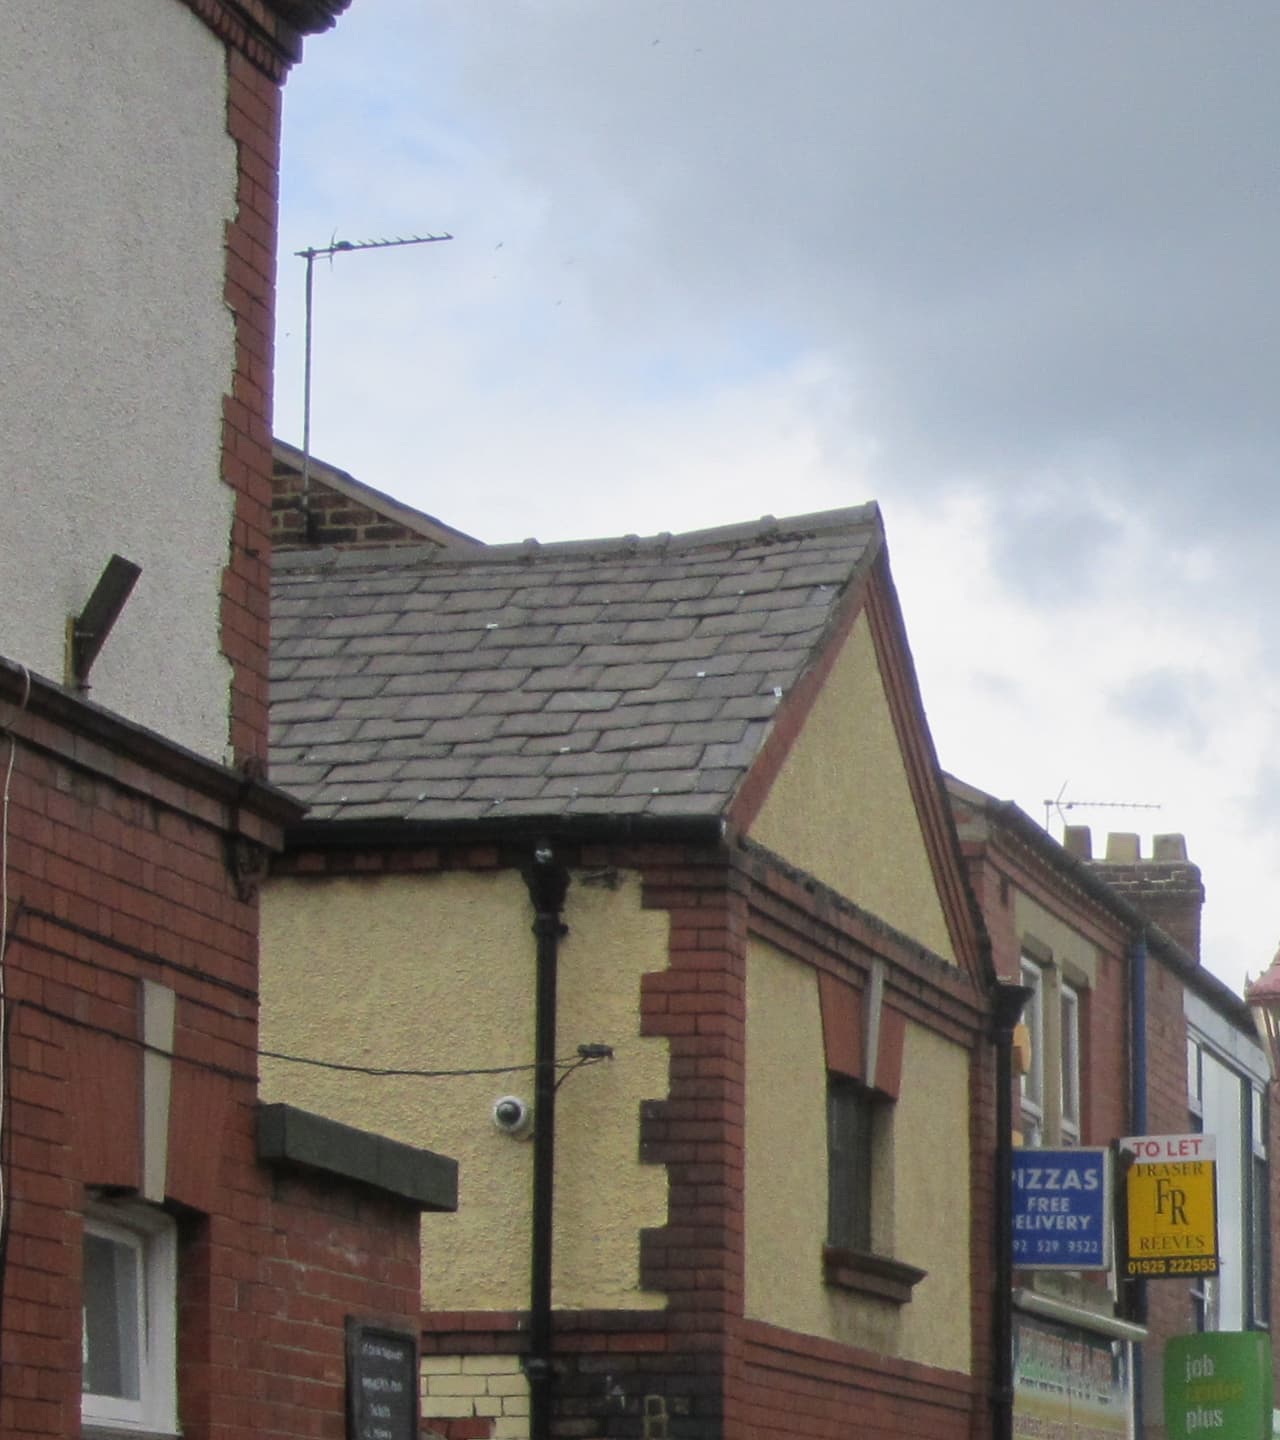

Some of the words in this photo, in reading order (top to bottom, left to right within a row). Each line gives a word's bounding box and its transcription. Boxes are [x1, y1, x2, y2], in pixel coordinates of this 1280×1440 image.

[1133, 1141, 1160, 1157] TO
[1167, 1139, 1203, 1156] LET
[1136, 1162, 1204, 1177] FRASER
[1012, 1168, 1098, 1190] IZZAS
[1027, 1197, 1070, 1213] FREE
[1012, 1215, 1091, 1231] ELIVERY
[1139, 1234, 1205, 1250] REEVES
[1128, 1260, 1165, 1274] 01925
[1185, 1354, 1215, 1383] job
[1186, 1407, 1223, 1435] plus
